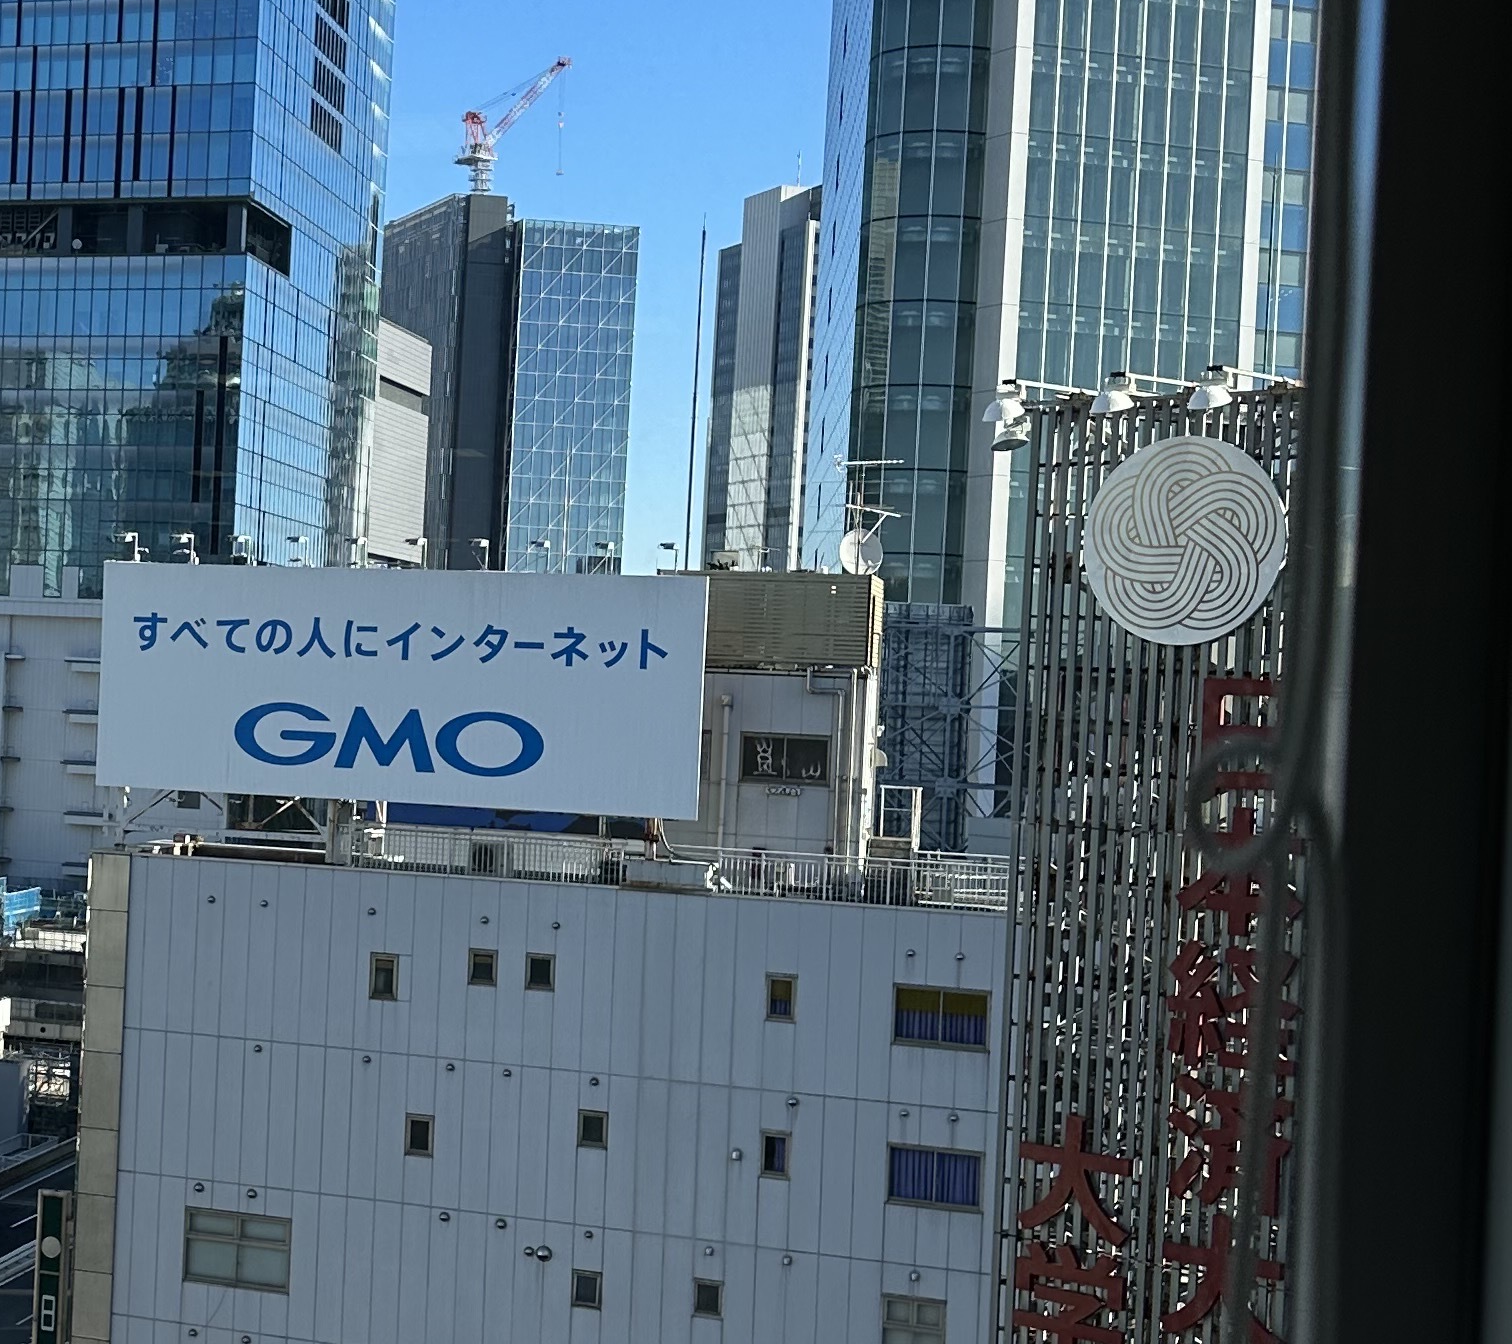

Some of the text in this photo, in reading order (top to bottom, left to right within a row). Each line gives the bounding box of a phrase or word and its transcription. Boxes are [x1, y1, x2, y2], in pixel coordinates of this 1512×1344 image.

[133, 612, 669, 670] すべての人にインターネット
[234, 701, 545, 778] GMO
